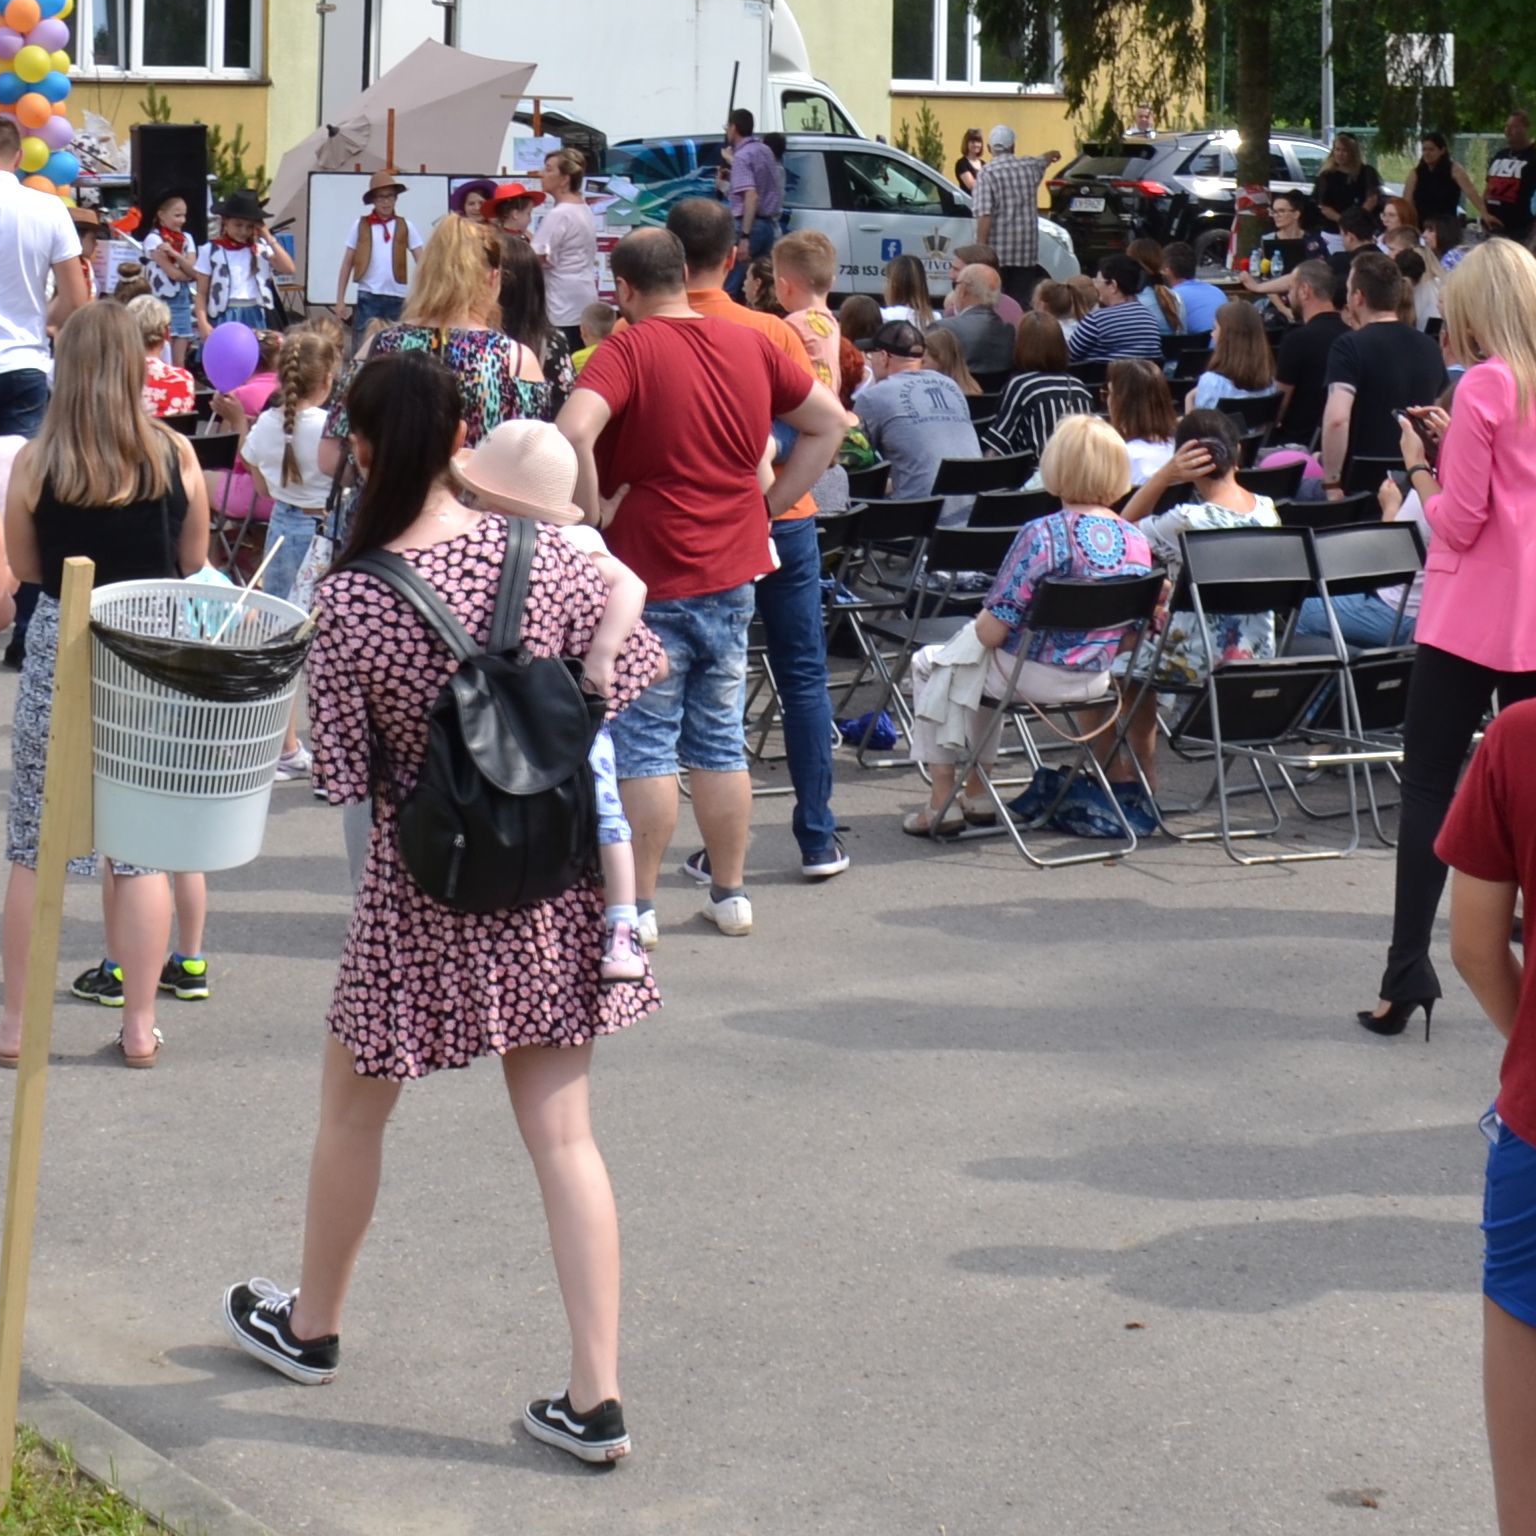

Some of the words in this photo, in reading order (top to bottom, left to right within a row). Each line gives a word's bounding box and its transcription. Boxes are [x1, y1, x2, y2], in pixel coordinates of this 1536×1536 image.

[839, 265, 859, 276] 728
[862, 266, 879, 276] 153
[923, 259, 953, 271] IVO
